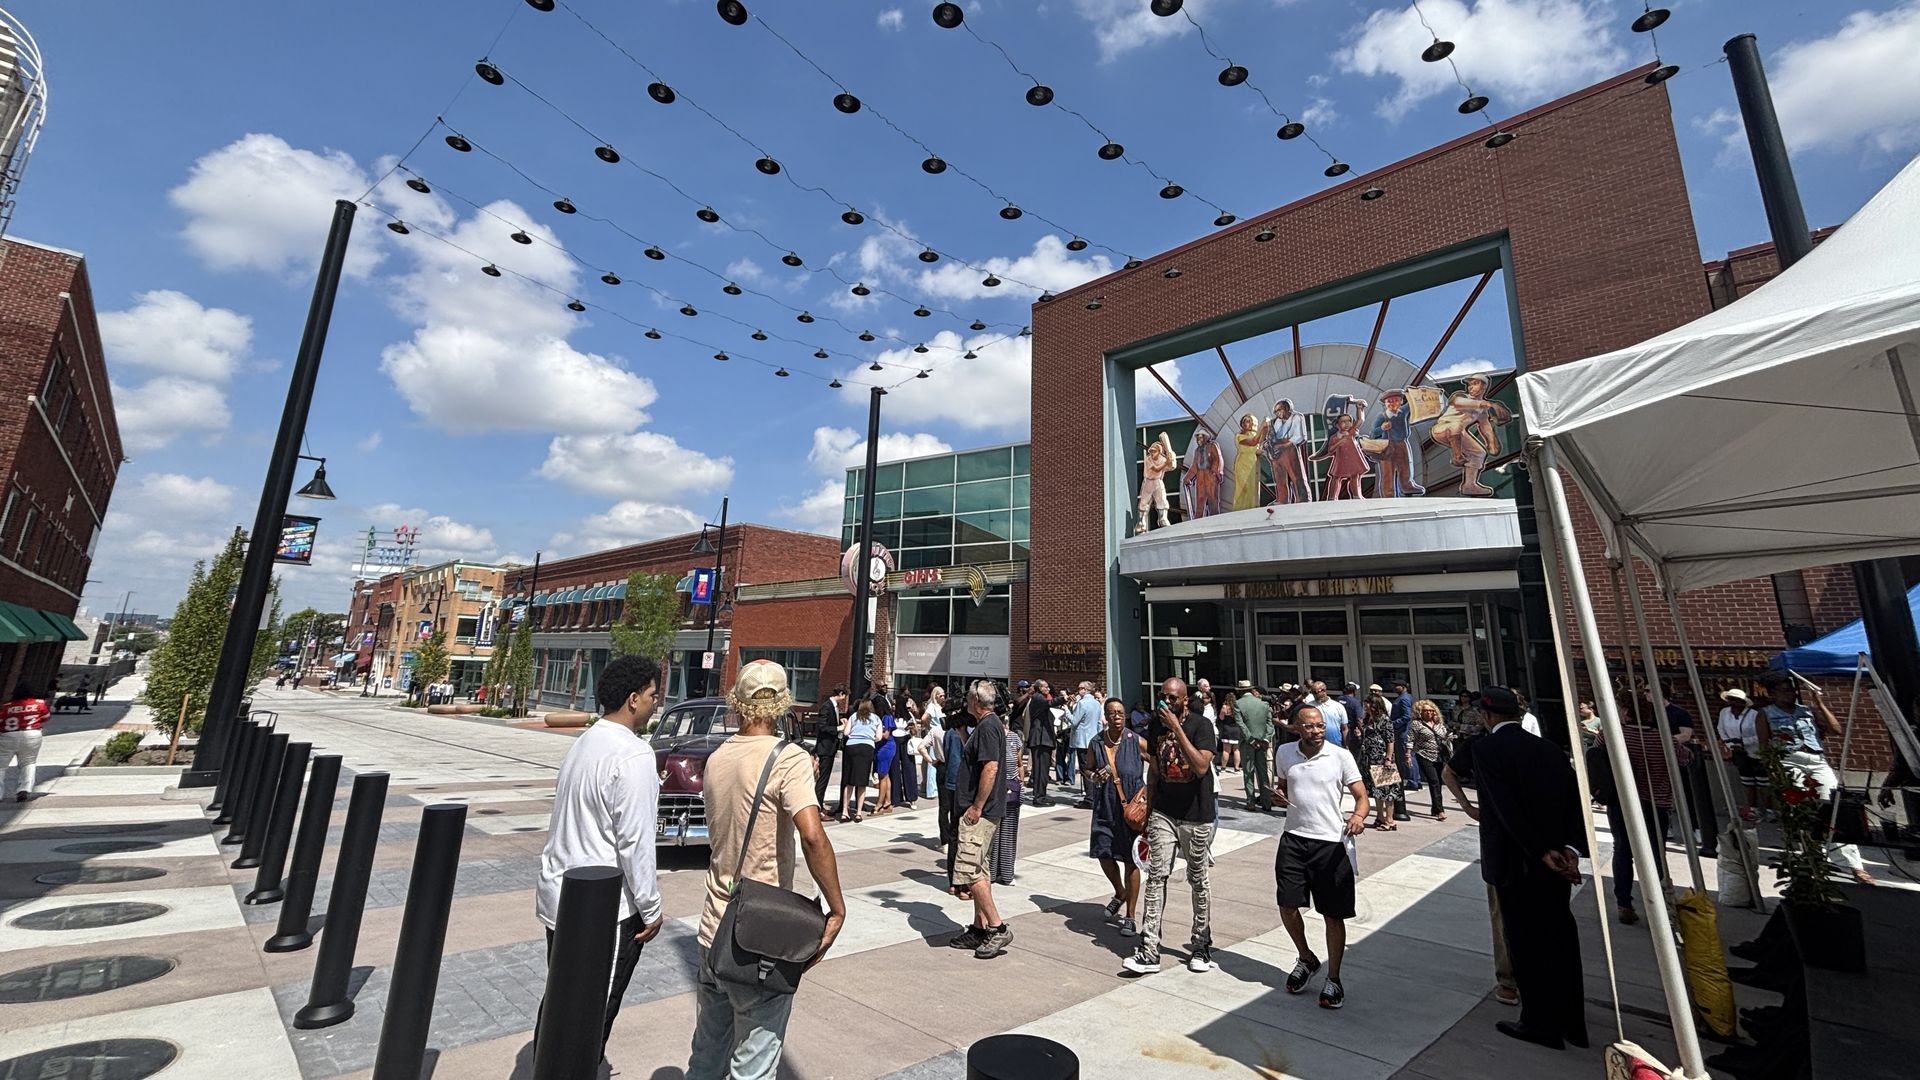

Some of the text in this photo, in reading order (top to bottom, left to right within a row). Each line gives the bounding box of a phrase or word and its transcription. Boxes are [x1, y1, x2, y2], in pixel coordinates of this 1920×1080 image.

[1350, 577, 1359, 594] &
[1364, 576, 1393, 594] VINE
[8, 704, 39, 713] KELCE
